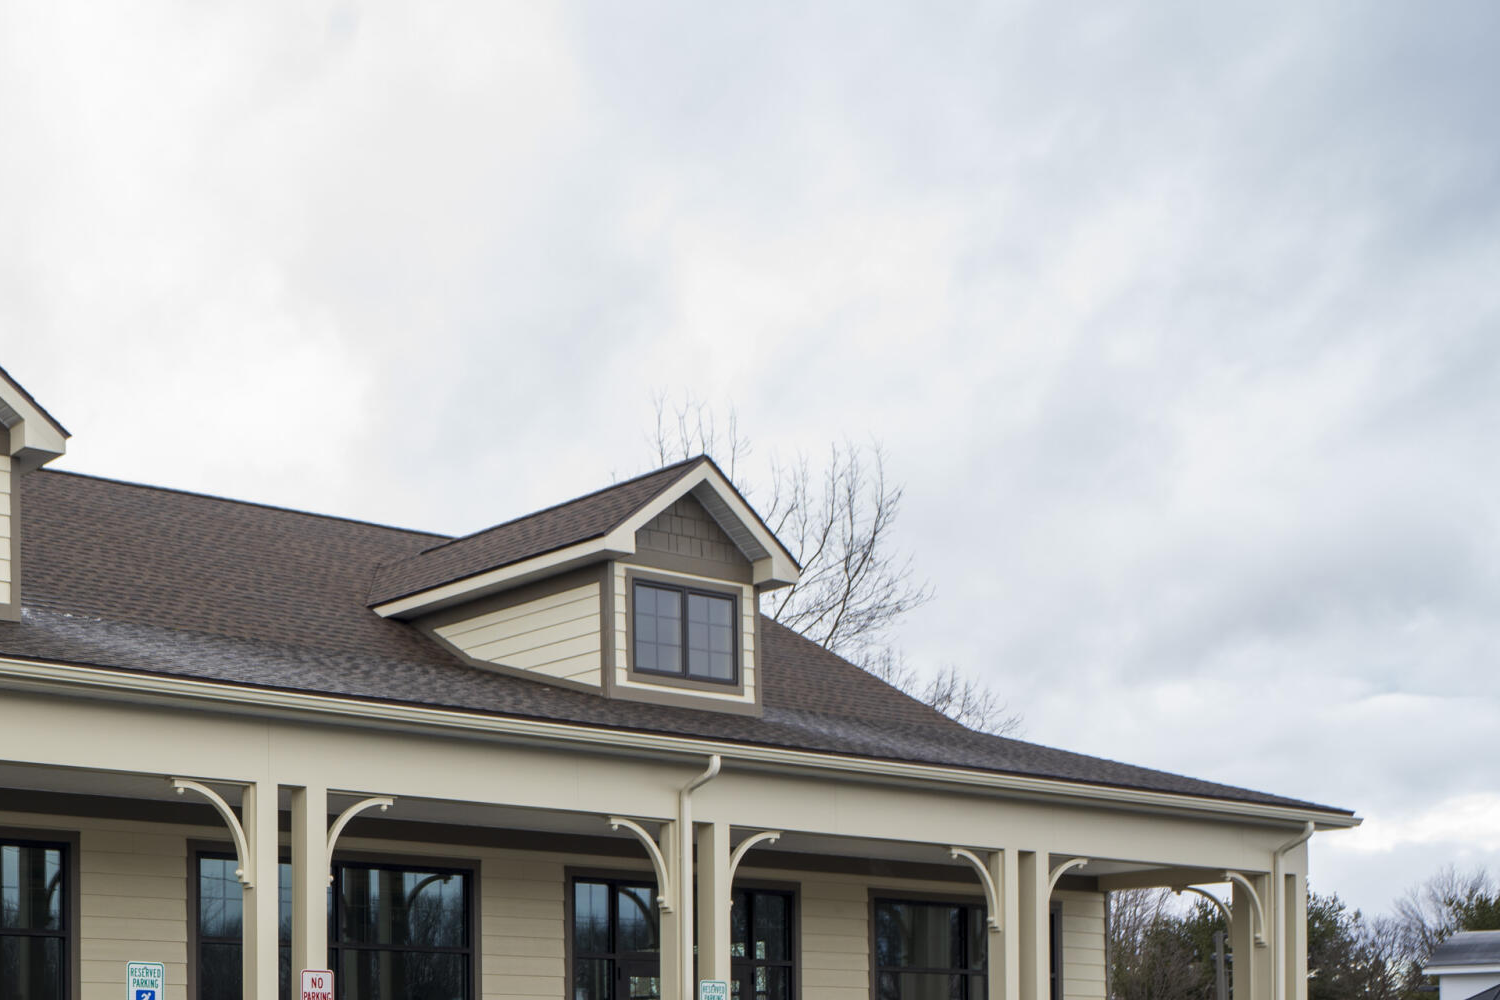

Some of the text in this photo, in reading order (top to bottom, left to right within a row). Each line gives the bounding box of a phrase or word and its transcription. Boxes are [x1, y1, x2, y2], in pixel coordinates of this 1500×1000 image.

[130, 967, 161, 978] RESERVED
[132, 978, 159, 989] PARKING
[311, 977, 324, 989] NO
